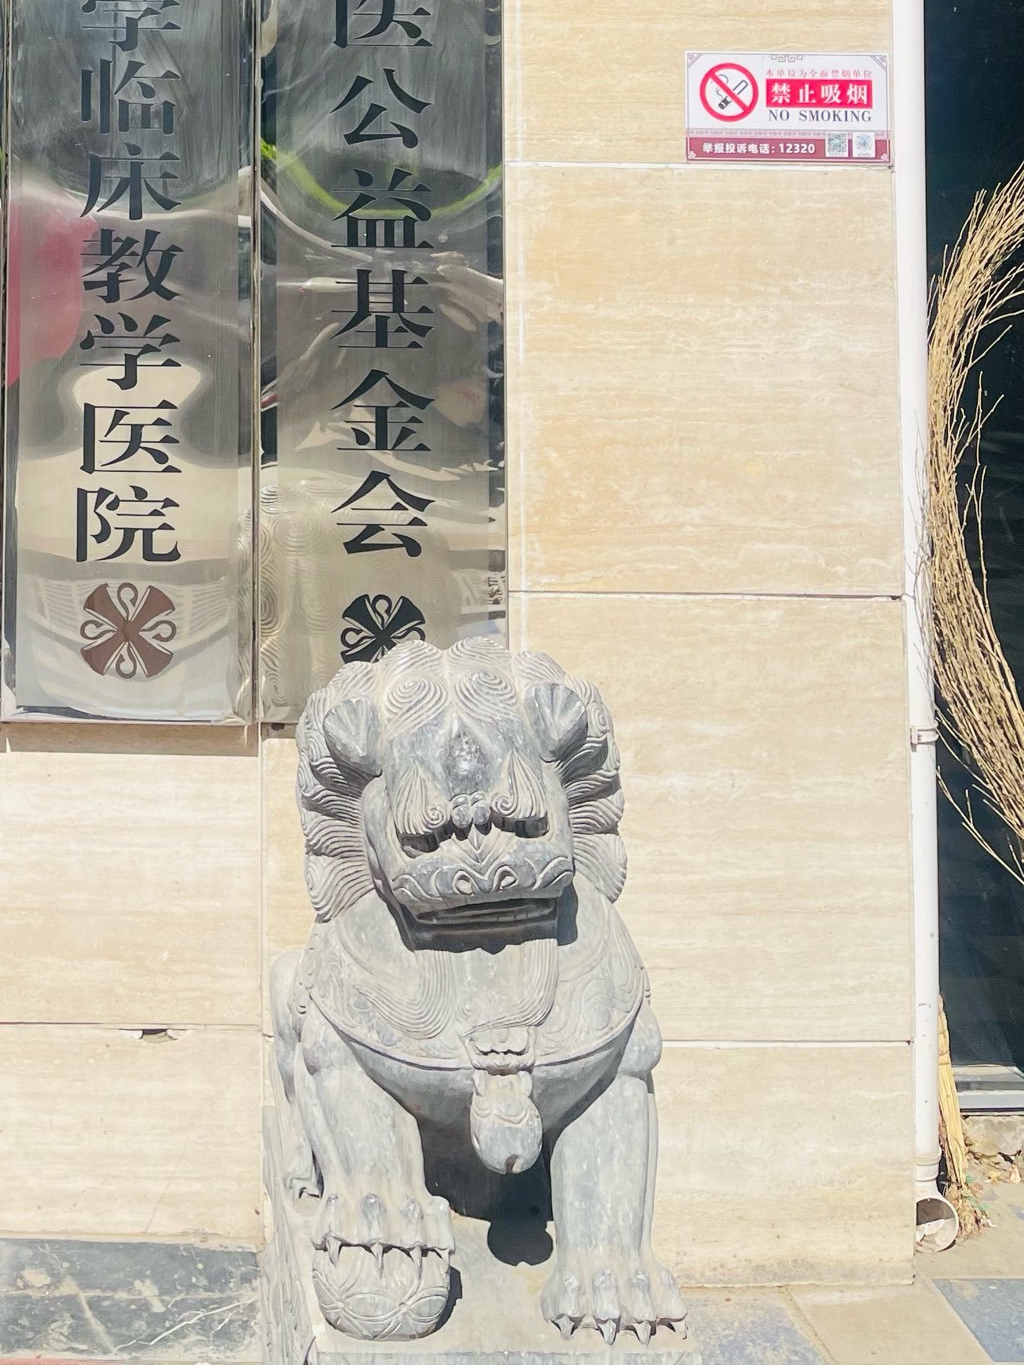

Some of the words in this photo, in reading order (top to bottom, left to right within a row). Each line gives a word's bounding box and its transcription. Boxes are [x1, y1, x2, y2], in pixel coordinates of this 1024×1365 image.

[771, 83, 868, 104] 禁止吸烟
[768, 110, 790, 121] NO
[799, 110, 872, 122] SMOKING
